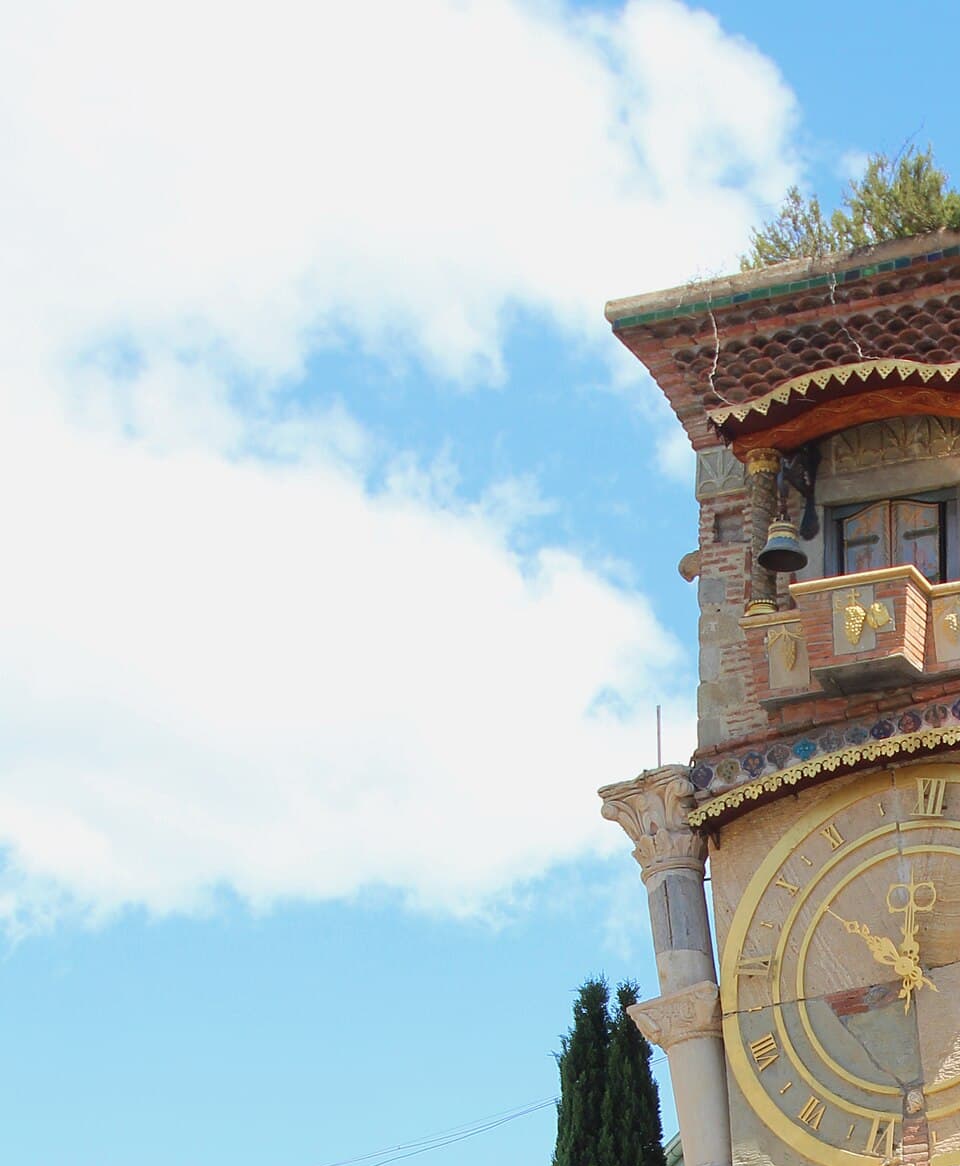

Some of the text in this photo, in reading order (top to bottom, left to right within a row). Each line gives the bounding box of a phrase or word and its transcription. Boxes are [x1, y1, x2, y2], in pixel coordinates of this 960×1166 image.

[909, 777, 946, 817] XII
[820, 824, 846, 852] XI
[775, 875, 801, 897] X
[733, 955, 774, 978] IX
[749, 1032, 779, 1072] VIII
[797, 1095, 827, 1131] VII
[861, 1115, 893, 1159] VI
